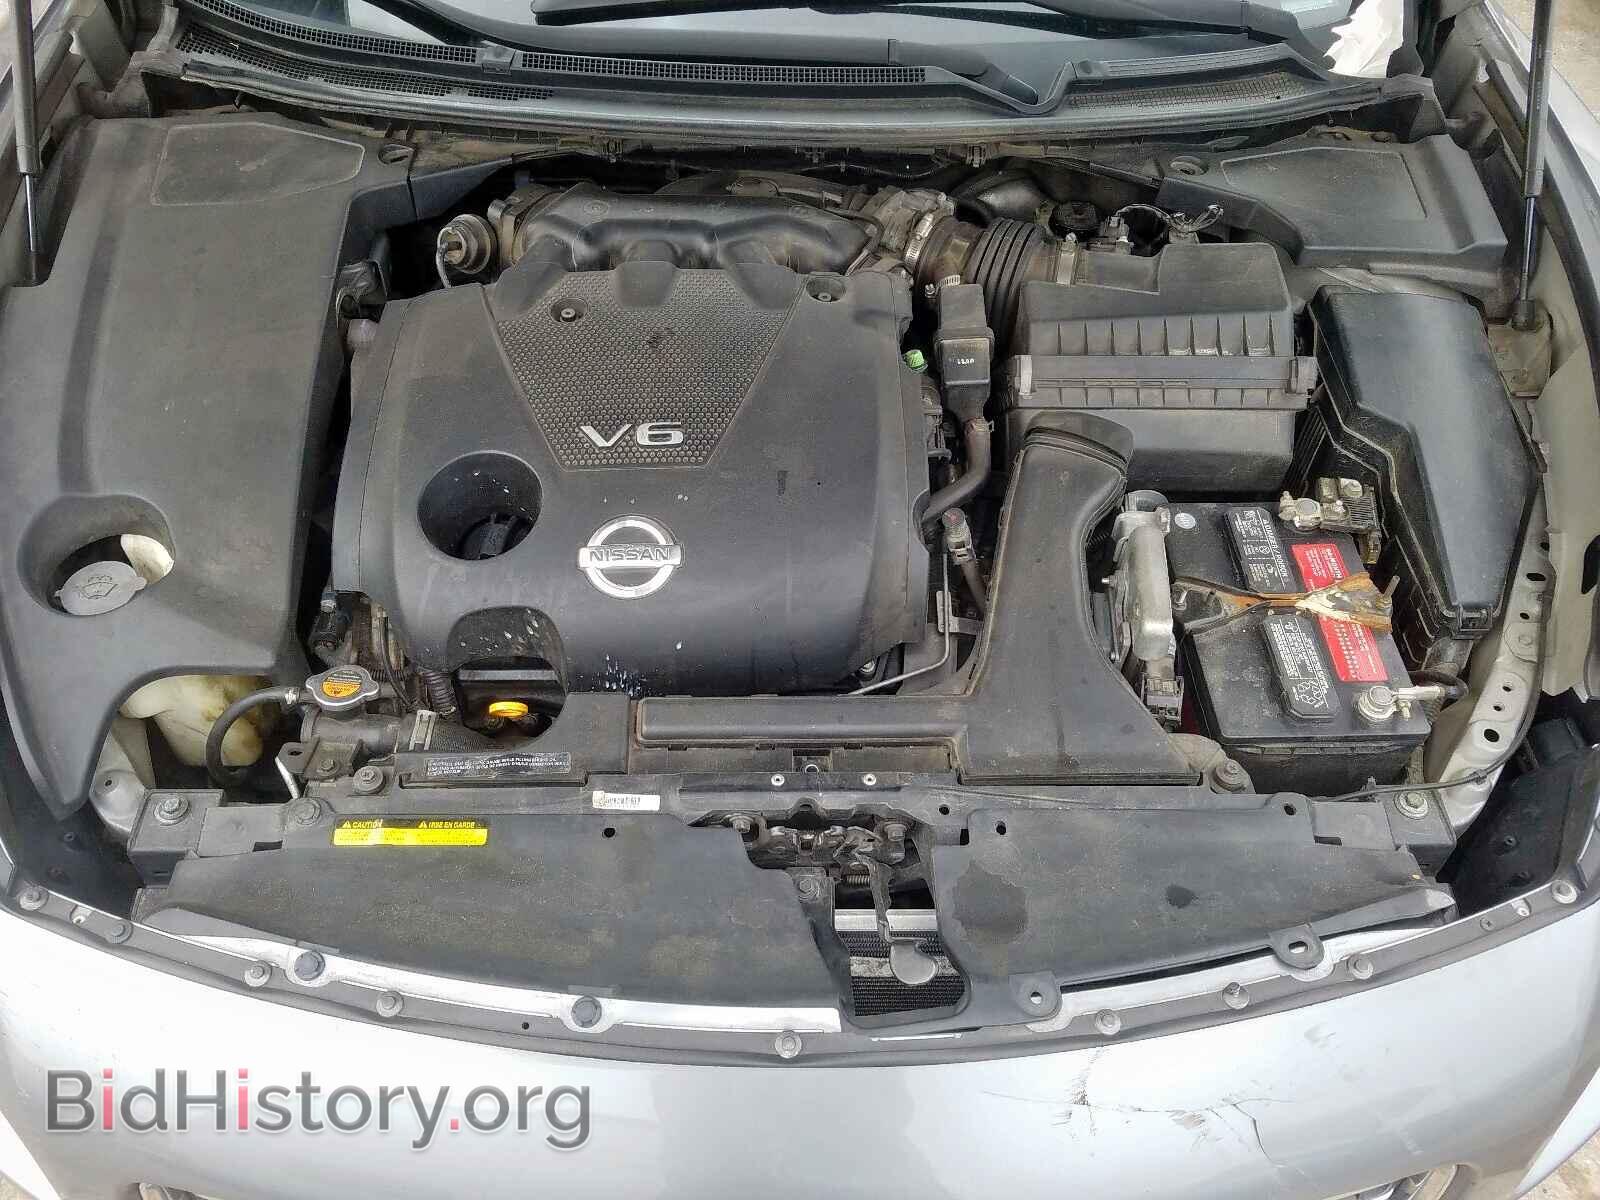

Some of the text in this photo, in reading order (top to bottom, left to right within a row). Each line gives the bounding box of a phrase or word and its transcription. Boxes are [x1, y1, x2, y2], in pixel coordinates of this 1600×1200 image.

[580, 422, 684, 446] V6
[589, 546, 671, 562] NISSAN
[352, 820, 383, 829] CAUTION
